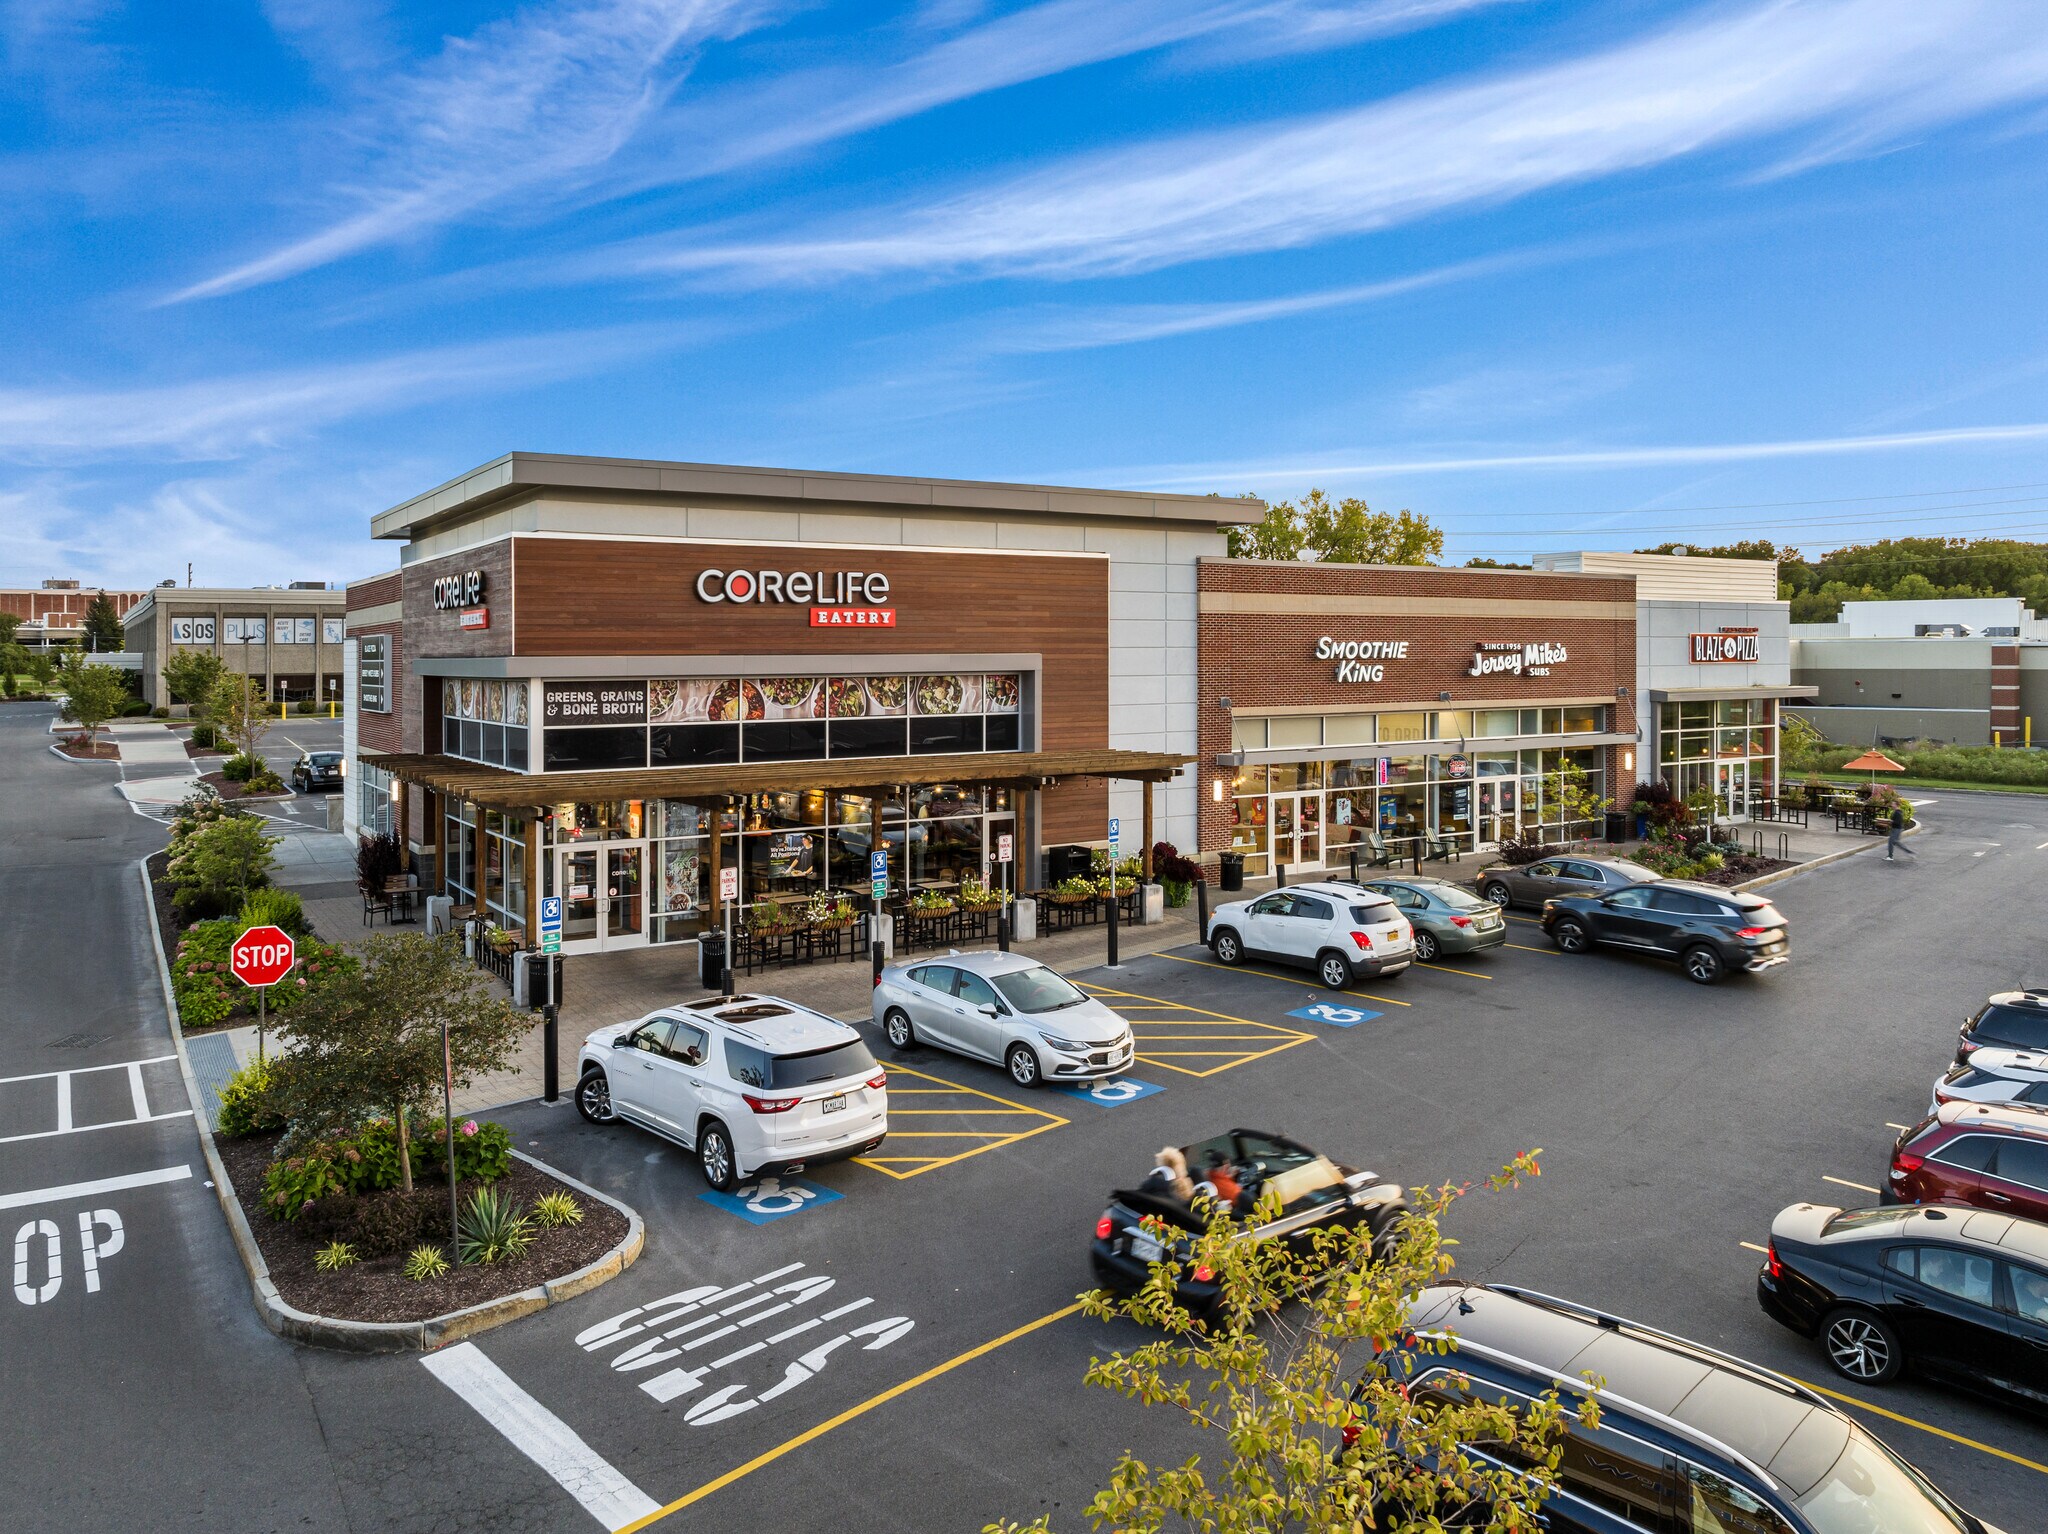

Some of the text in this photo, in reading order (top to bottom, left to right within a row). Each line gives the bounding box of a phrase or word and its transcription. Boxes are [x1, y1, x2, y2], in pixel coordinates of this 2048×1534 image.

[817, 611, 892, 624] EATERY
[182, 624, 265, 639] SOS PLUS
[1316, 636, 1409, 659] SMOOTHIE
[1696, 636, 1760, 661] BLAZE PIZZA
[1471, 642, 1568, 677] Jersey Mike's
[1529, 667, 1550, 676] SUBS
[547, 690, 644, 703] GREENS, GRAINS
[547, 703, 644, 716] & BONE BROTH
[236, 943, 290, 969] STOP
[575, 1262, 915, 1427] STOP
